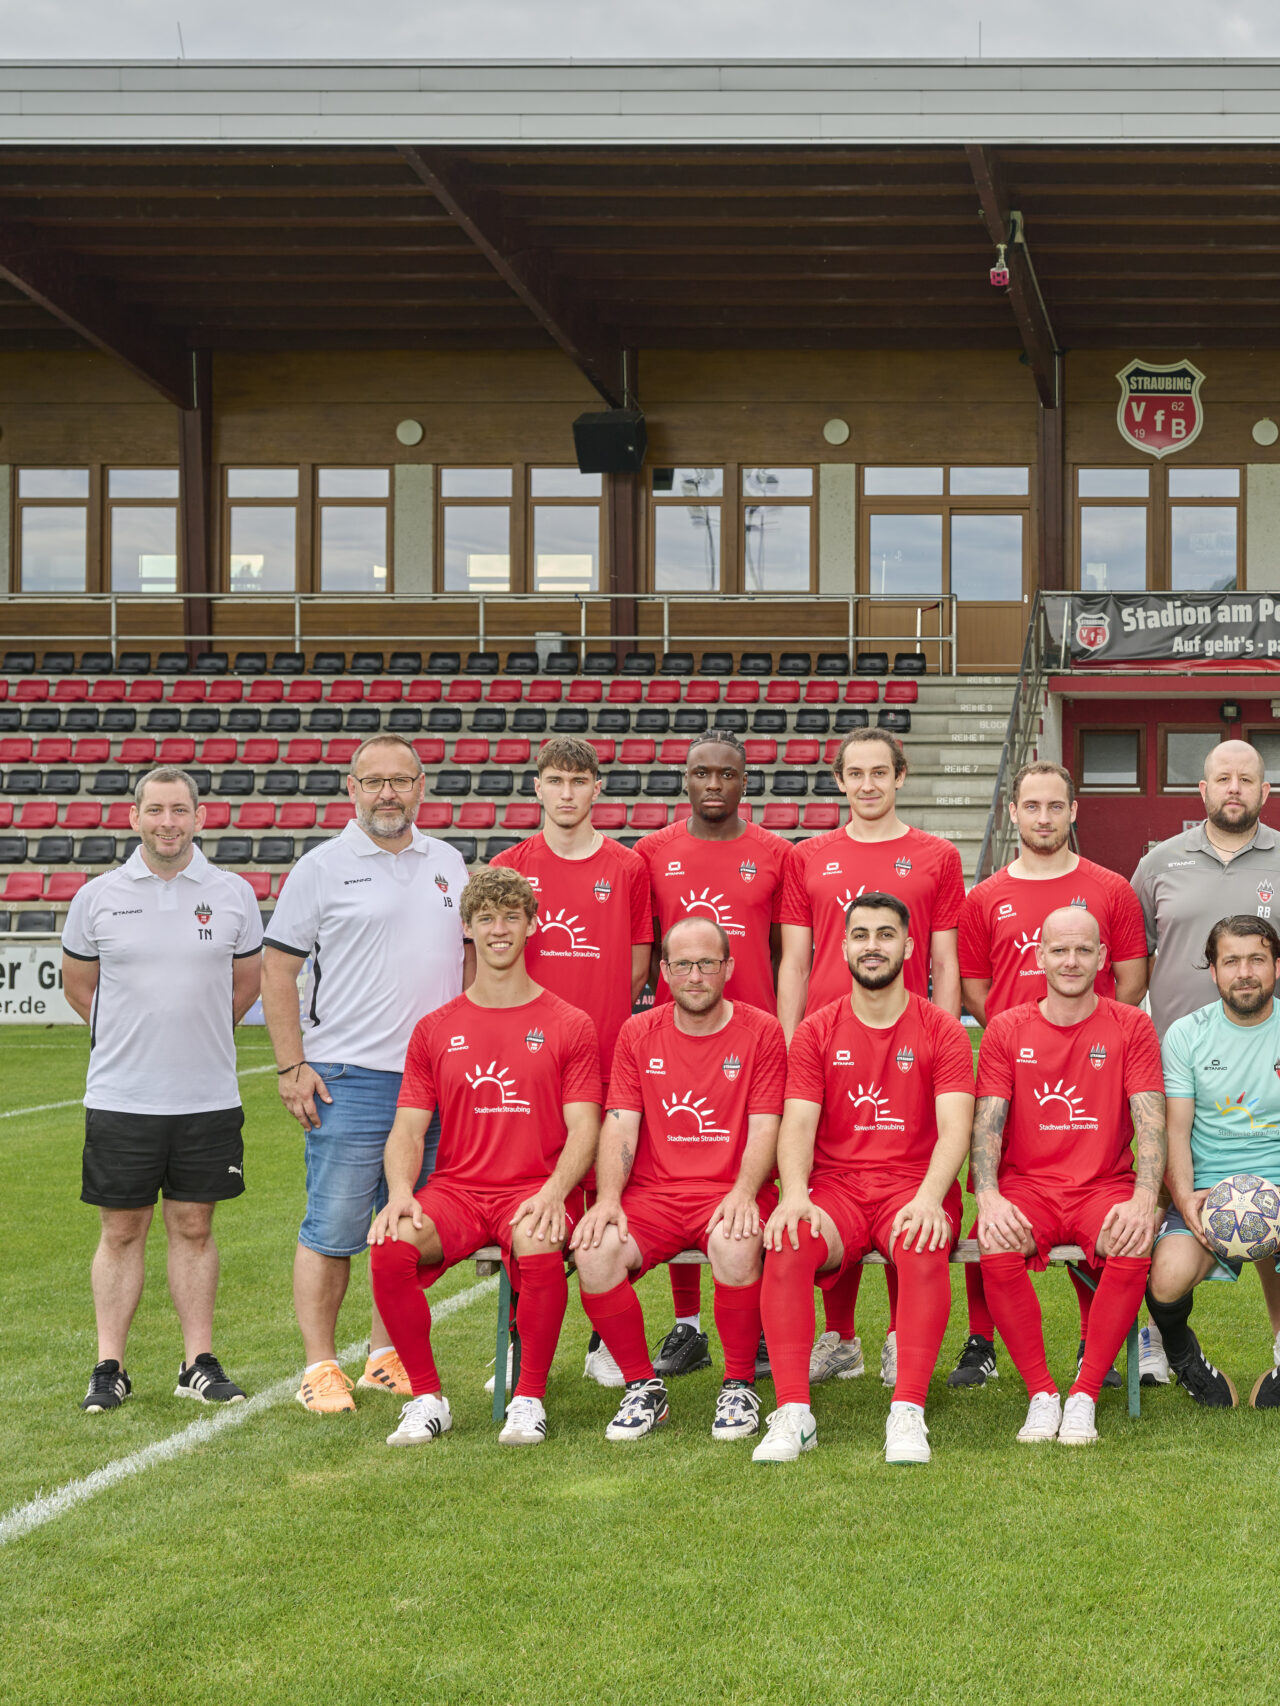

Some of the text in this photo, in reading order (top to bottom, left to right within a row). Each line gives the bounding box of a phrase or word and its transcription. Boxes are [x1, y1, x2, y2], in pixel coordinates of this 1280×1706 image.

[1130, 376, 1192, 391] STRAUBING
[1171, 402, 1184, 411] 62
[1134, 428, 1146, 439] 19
[1121, 601, 1212, 632] Stadion
[1217, 604, 1253, 623] am
[1172, 636, 1202, 653] Auf
[1205, 635, 1254, 656] geht's
[960, 704, 986, 712] REIHE
[951, 734, 977, 742] REIHE
[944, 765, 970, 773] REIHE
[936, 797, 961, 805] REIHE
[1168, 860, 1196, 868] STANNO
[344, 877, 372, 885] STANNO
[1257, 905, 1271, 918] RB
[198, 929, 213, 940] TN
[540, 949, 600, 959] Stadtwerke Straubing
[502, 1106, 531, 1115] Straubing
[877, 1123, 905, 1132] Straubing
[1039, 1123, 1099, 1132] Stadtwerke Straubing
[667, 1135, 730, 1143] Stadtwerke Straubing
